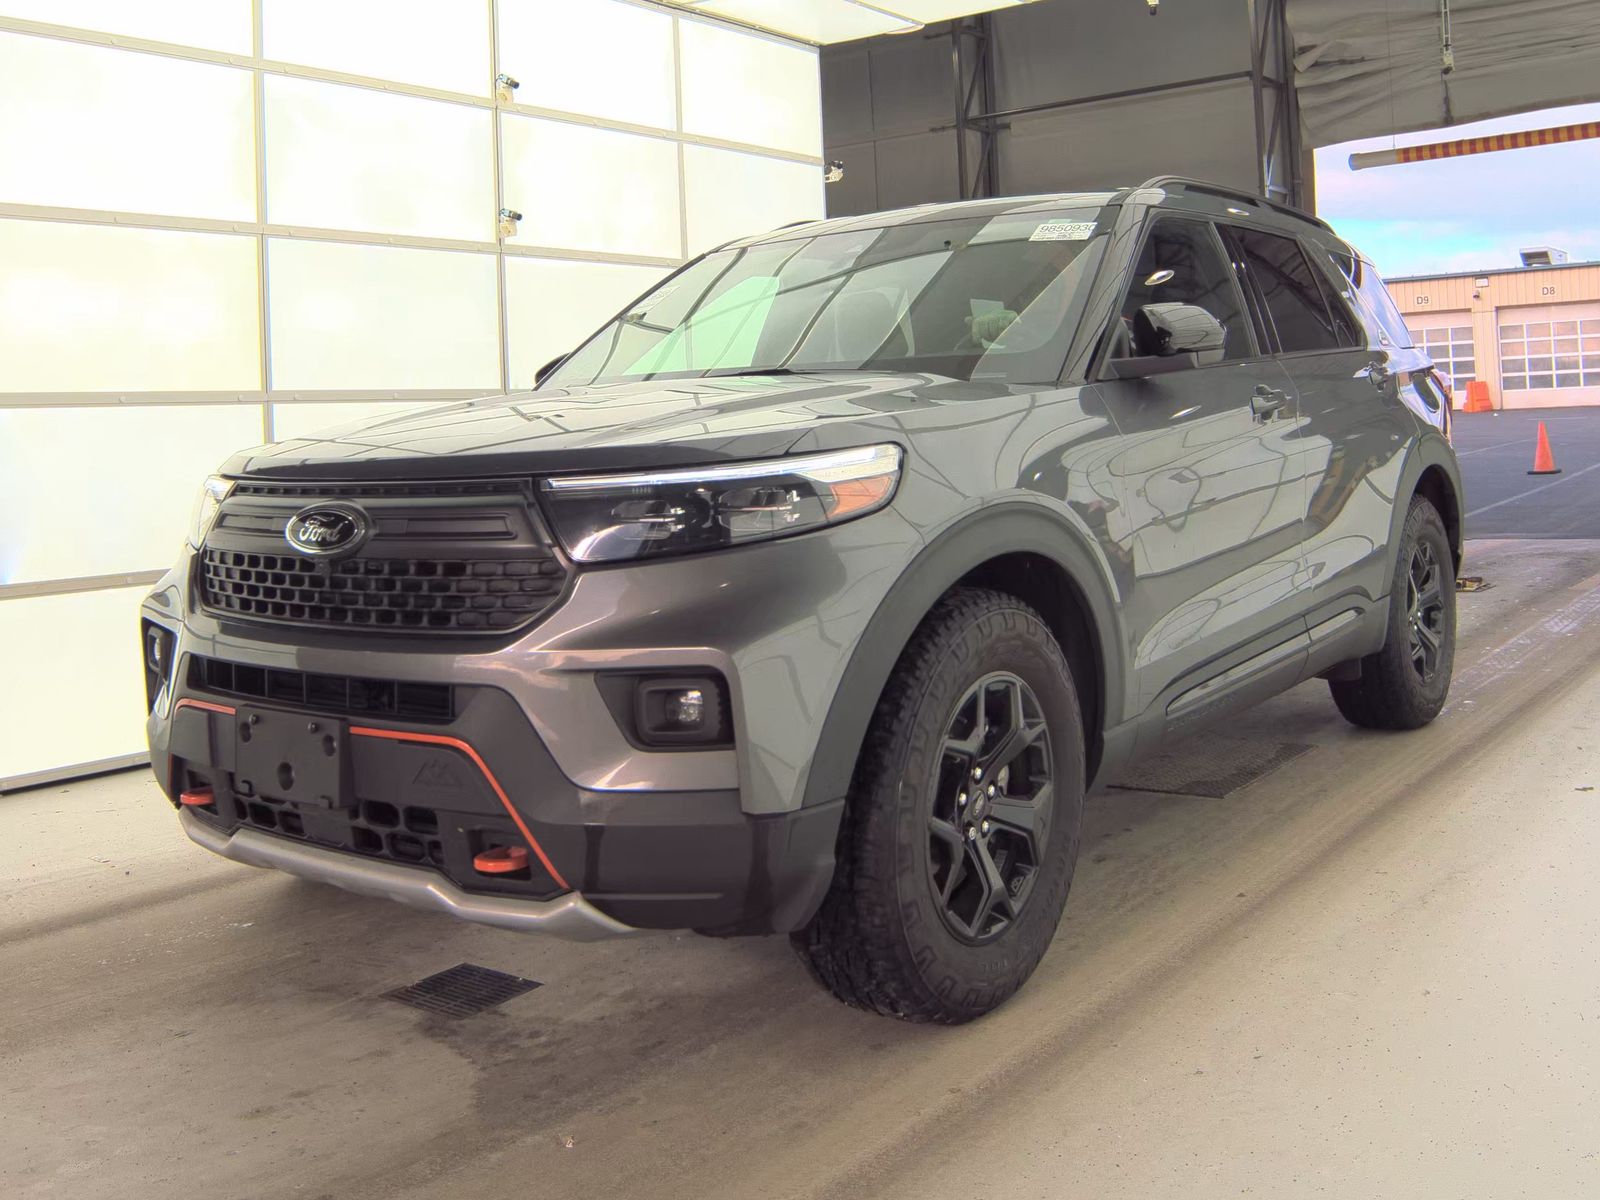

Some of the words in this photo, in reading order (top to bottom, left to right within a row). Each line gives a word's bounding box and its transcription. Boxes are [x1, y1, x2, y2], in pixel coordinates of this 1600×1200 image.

[1542, 287, 1556, 296] D8
[1416, 296, 1429, 305] D9
[299, 515, 349, 542] Ford
